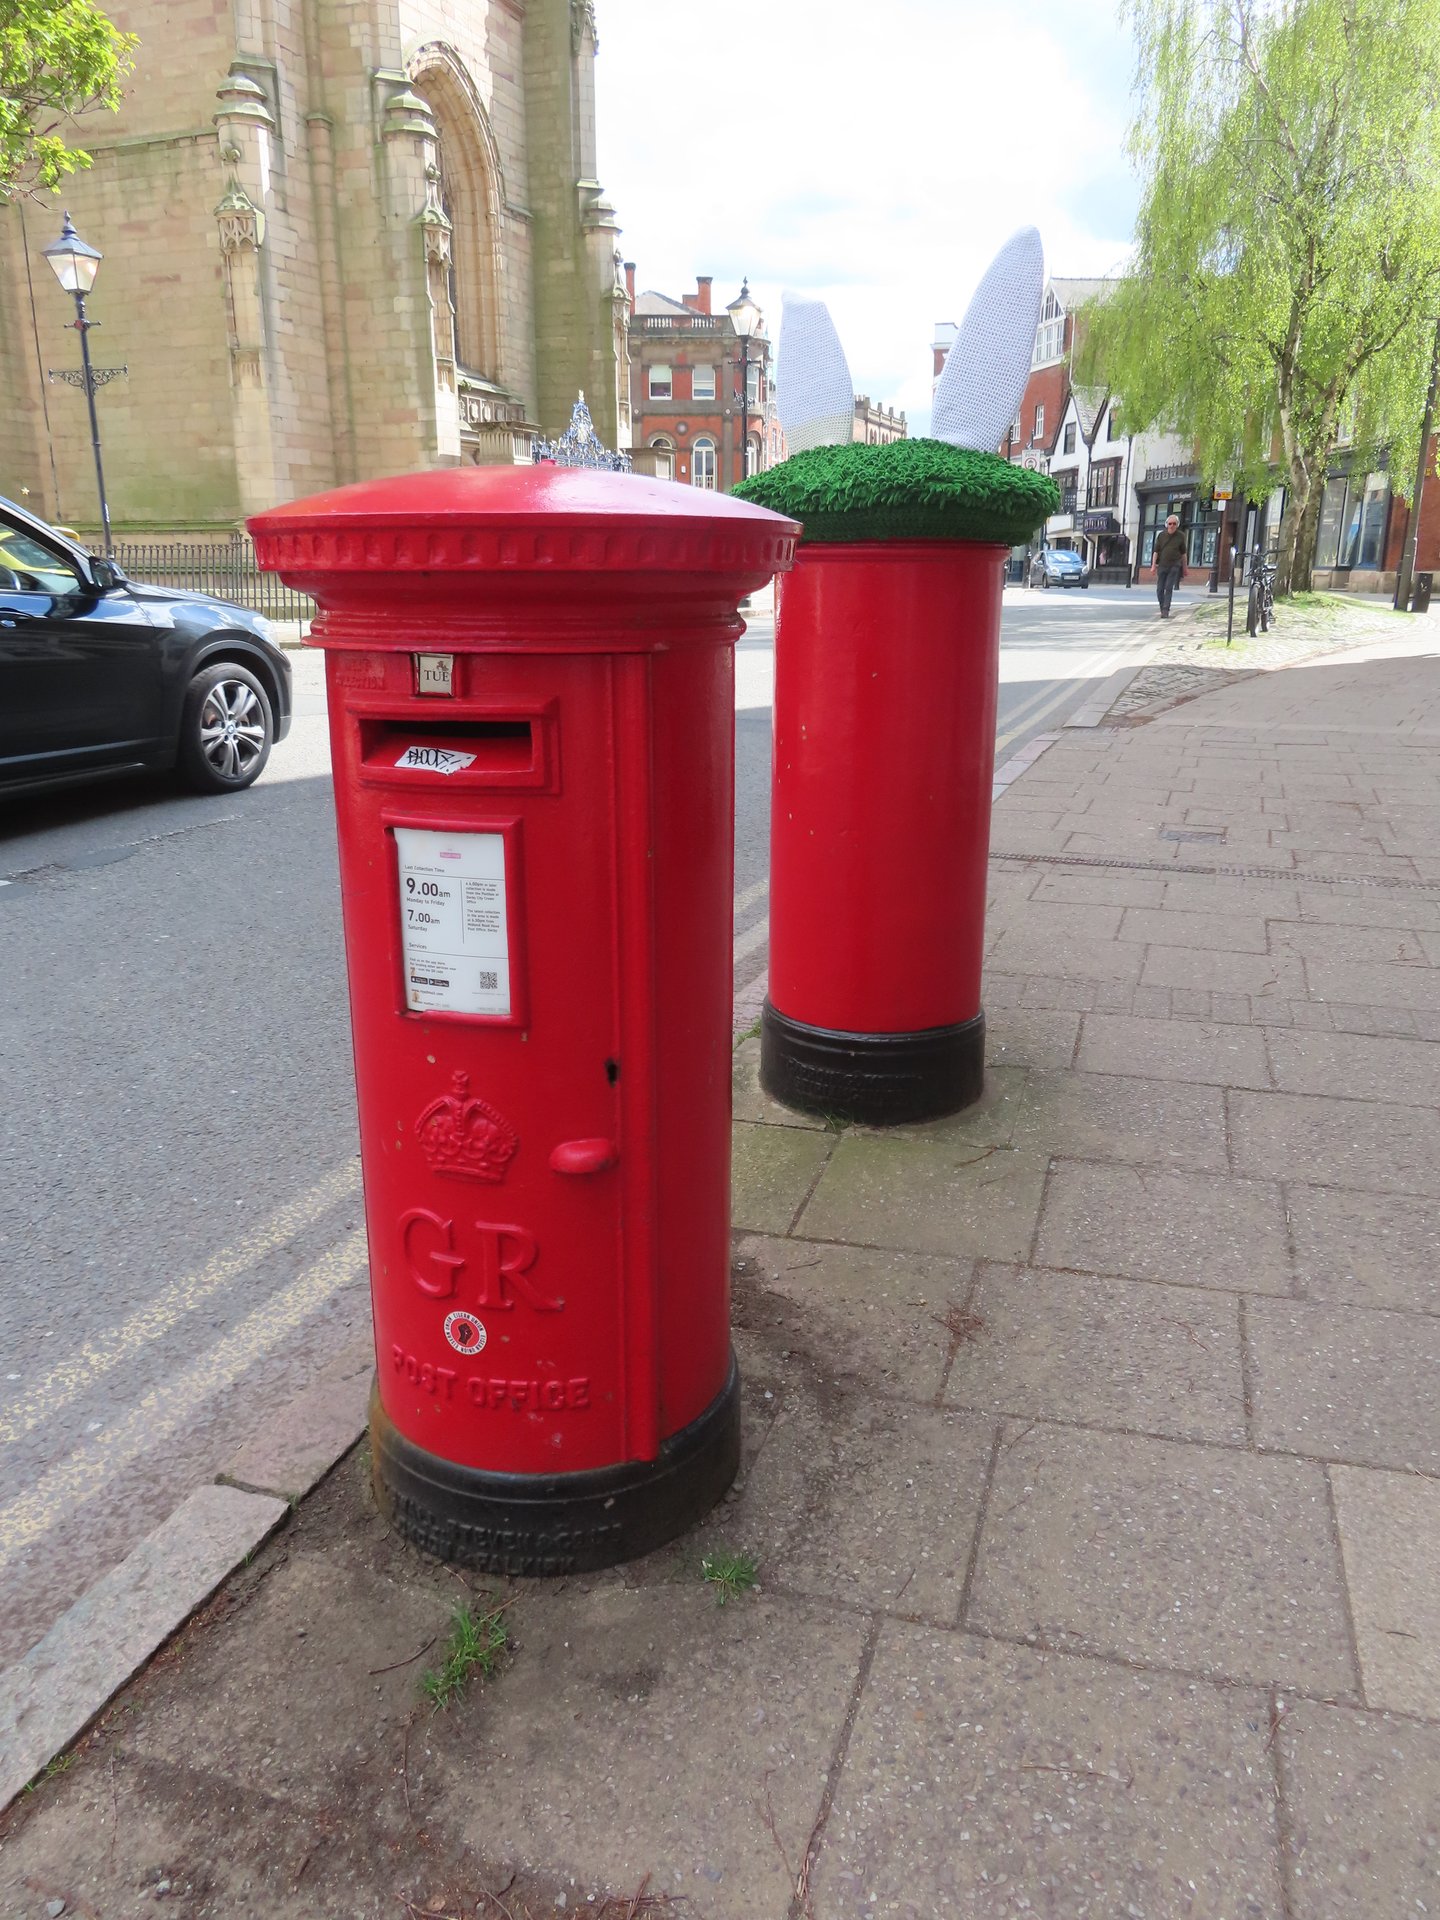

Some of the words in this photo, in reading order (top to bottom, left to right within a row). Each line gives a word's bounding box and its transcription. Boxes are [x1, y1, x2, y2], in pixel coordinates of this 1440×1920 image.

[424, 670, 449, 682] TUE
[392, 1344, 457, 1401] POST
[467, 1377, 591, 1411] OFFICE
